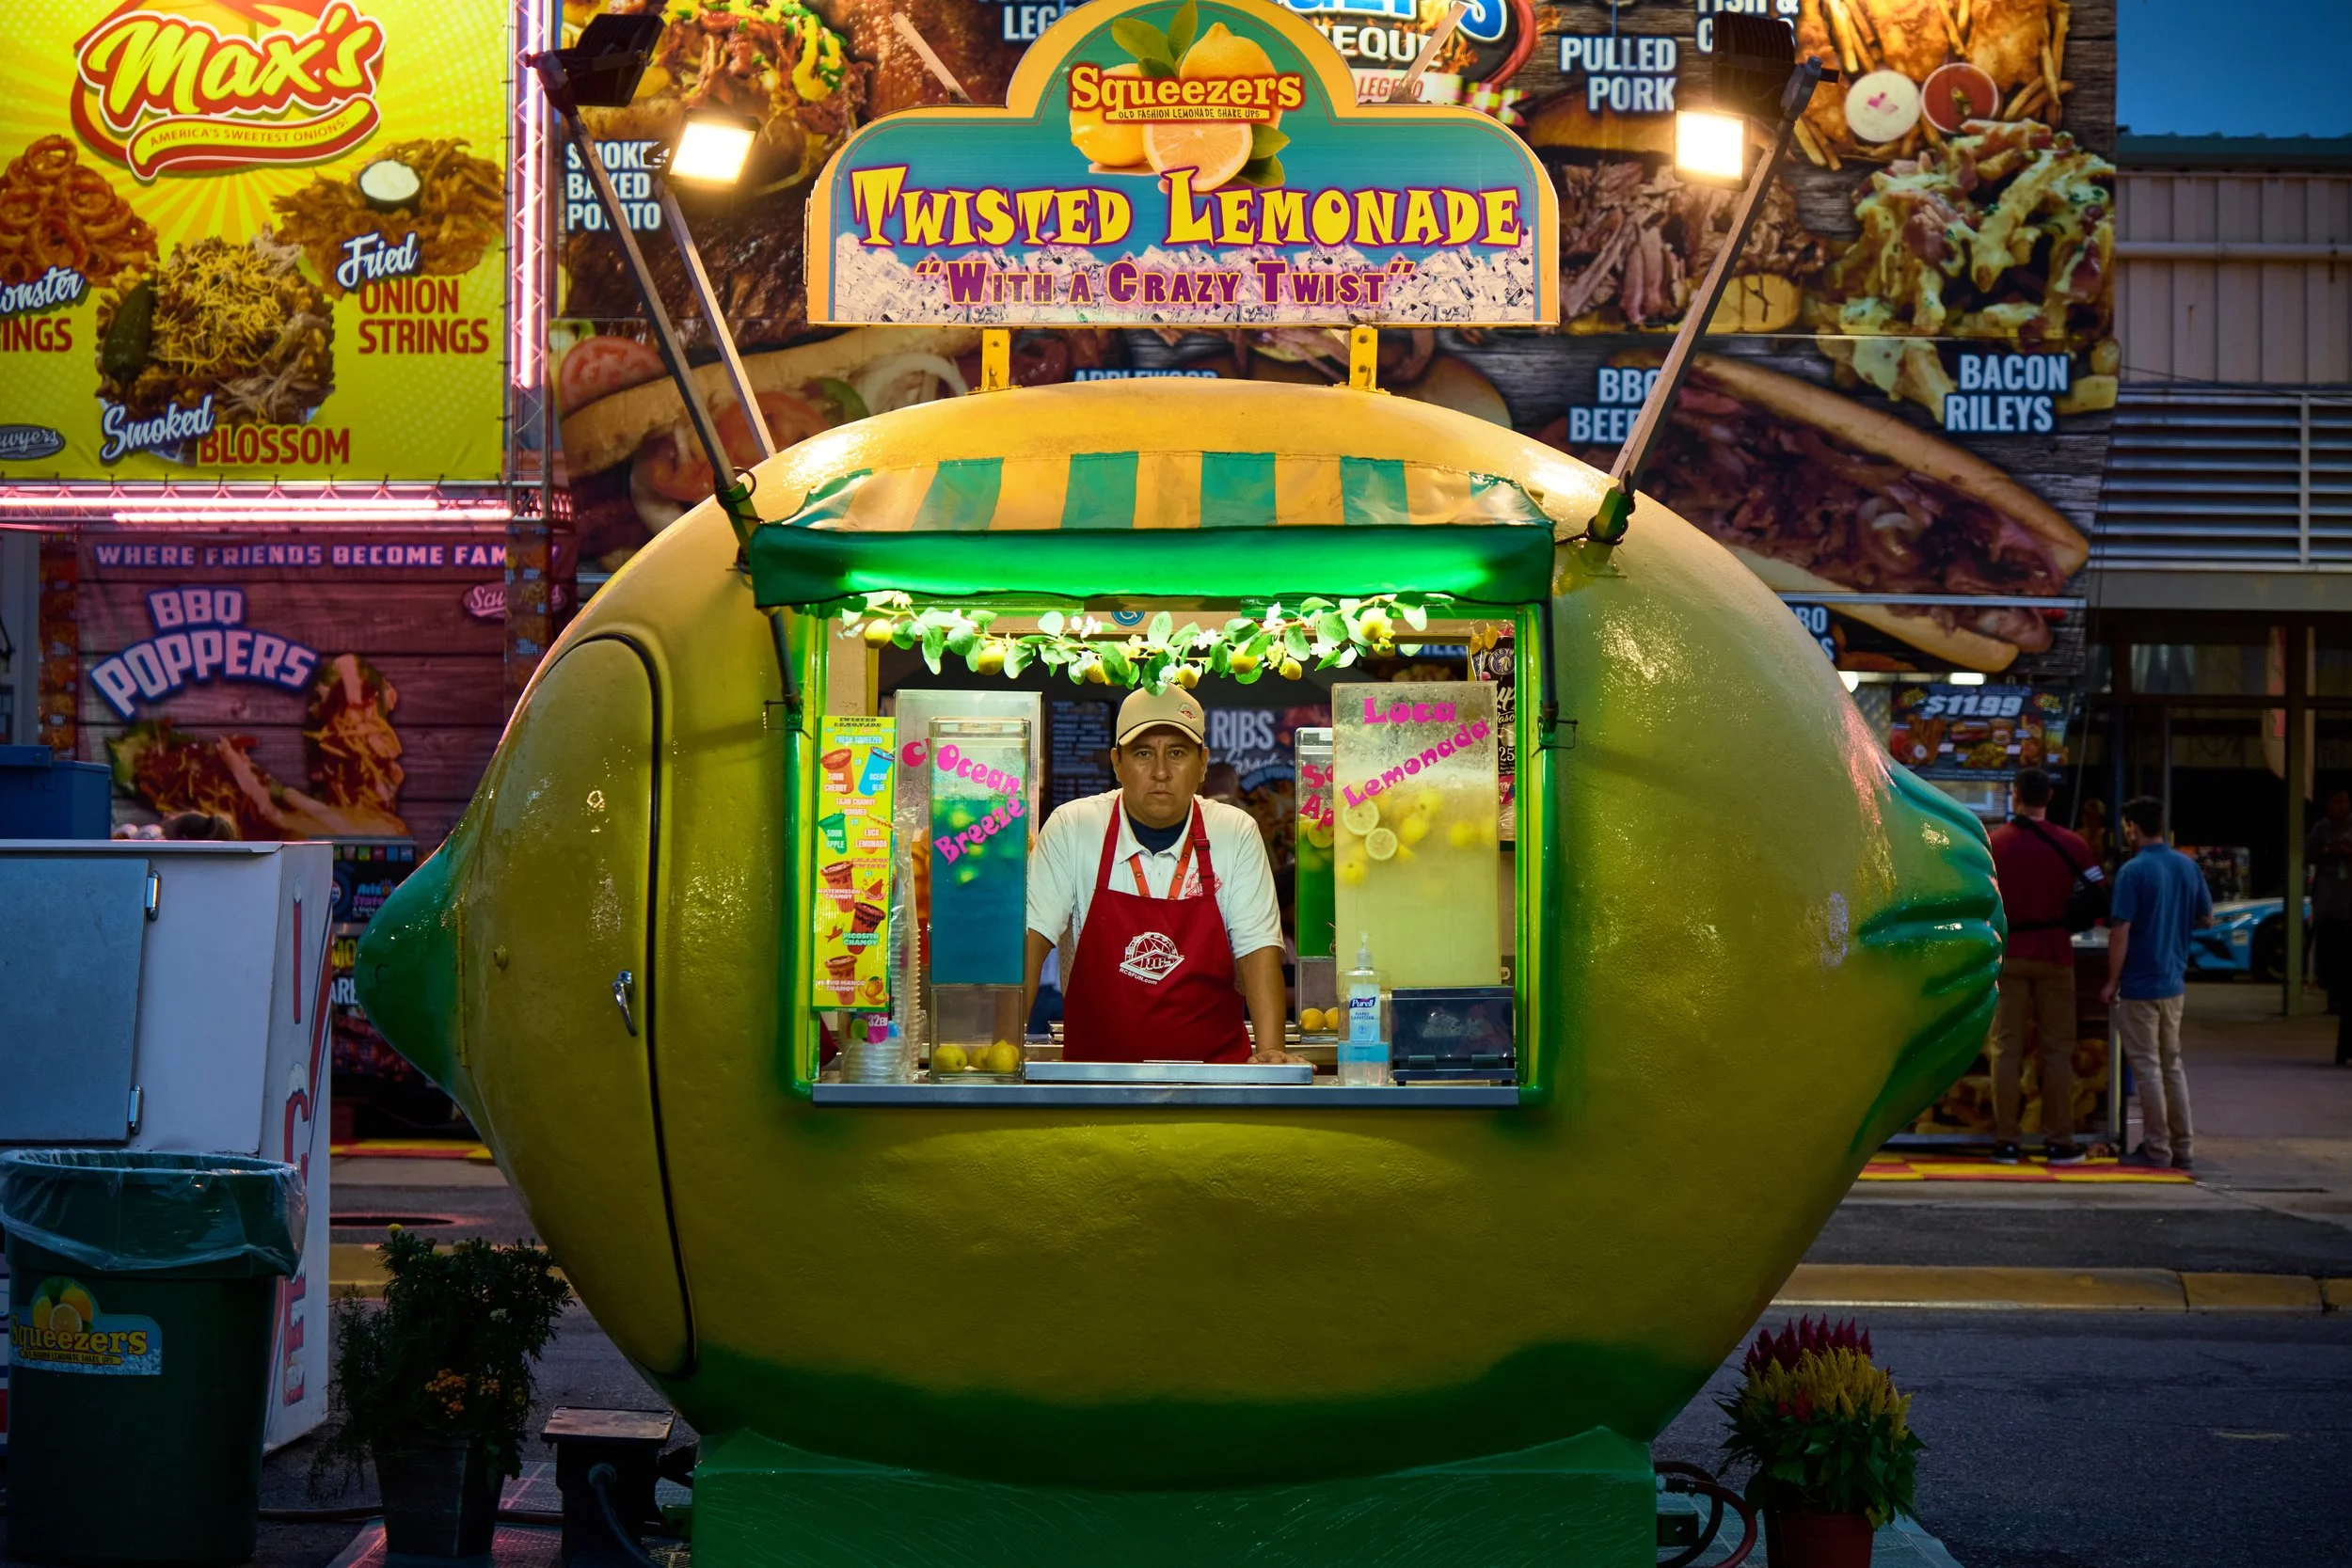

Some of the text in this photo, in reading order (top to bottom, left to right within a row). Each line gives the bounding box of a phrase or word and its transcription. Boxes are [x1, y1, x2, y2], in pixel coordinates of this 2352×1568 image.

[87, 8, 373, 114] Max's
[1560, 37, 1677, 71] PULLED
[1072, 67, 1301, 111] Squeezers
[1588, 77, 1675, 111] PORK
[1118, 107, 1261, 119] OLD FASHION LEMONADE SHAKE UPS
[150, 128, 219, 147] AMERICA'S
[224, 129, 289, 142] SWEETEST
[850, 166, 1522, 246] TWISTED LEMONADE
[338, 233, 417, 288] Fried
[0, 266, 84, 312] onster
[360, 280, 459, 314] ONION
[1069, 273, 1092, 303] A
[1107, 261, 1241, 304] CRAZY
[358, 319, 488, 354] STRINGS
[1960, 355, 2068, 391] BACON
[101, 394, 215, 460] Smoked
[1946, 396, 2052, 432] RILEYS
[199, 428, 348, 463] BLOSSOM
[96, 545, 195, 564] WHERE
[206, 546, 323, 564] FRIENDS
[332, 546, 444, 564] BECOME
[150, 588, 245, 627] BBQ
[91, 628, 317, 719] POPPERS
[1211, 709, 1276, 750] RIBS
[1362, 697, 1456, 724] Loca
[936, 744, 1021, 798] Ocean
[1343, 720, 1491, 809] Lemonada
[933, 795, 1025, 865] Breeze
[11, 1315, 148, 1355] Squeezers
